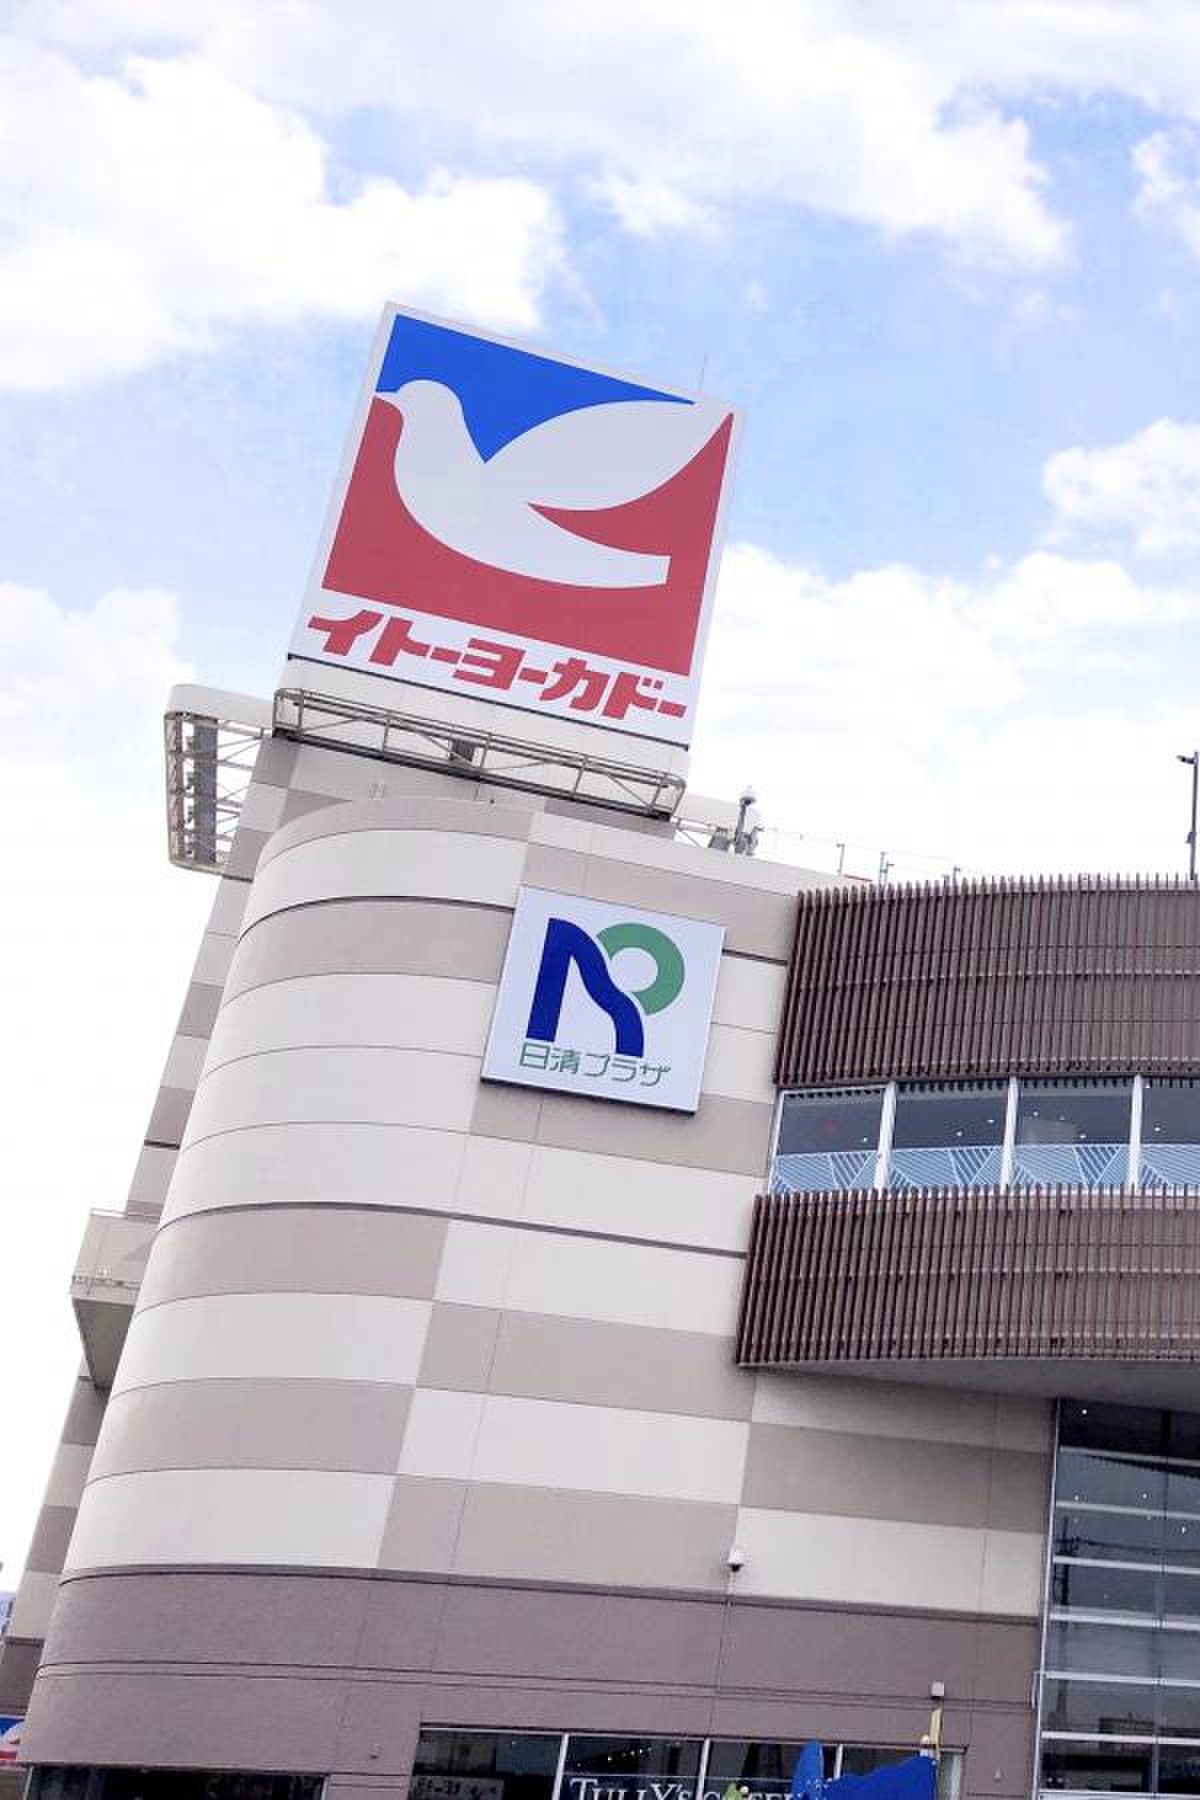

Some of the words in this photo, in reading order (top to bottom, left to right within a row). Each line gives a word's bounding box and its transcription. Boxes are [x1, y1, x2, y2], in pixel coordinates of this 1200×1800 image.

[307, 608, 687, 719] イトーヨーカドー
